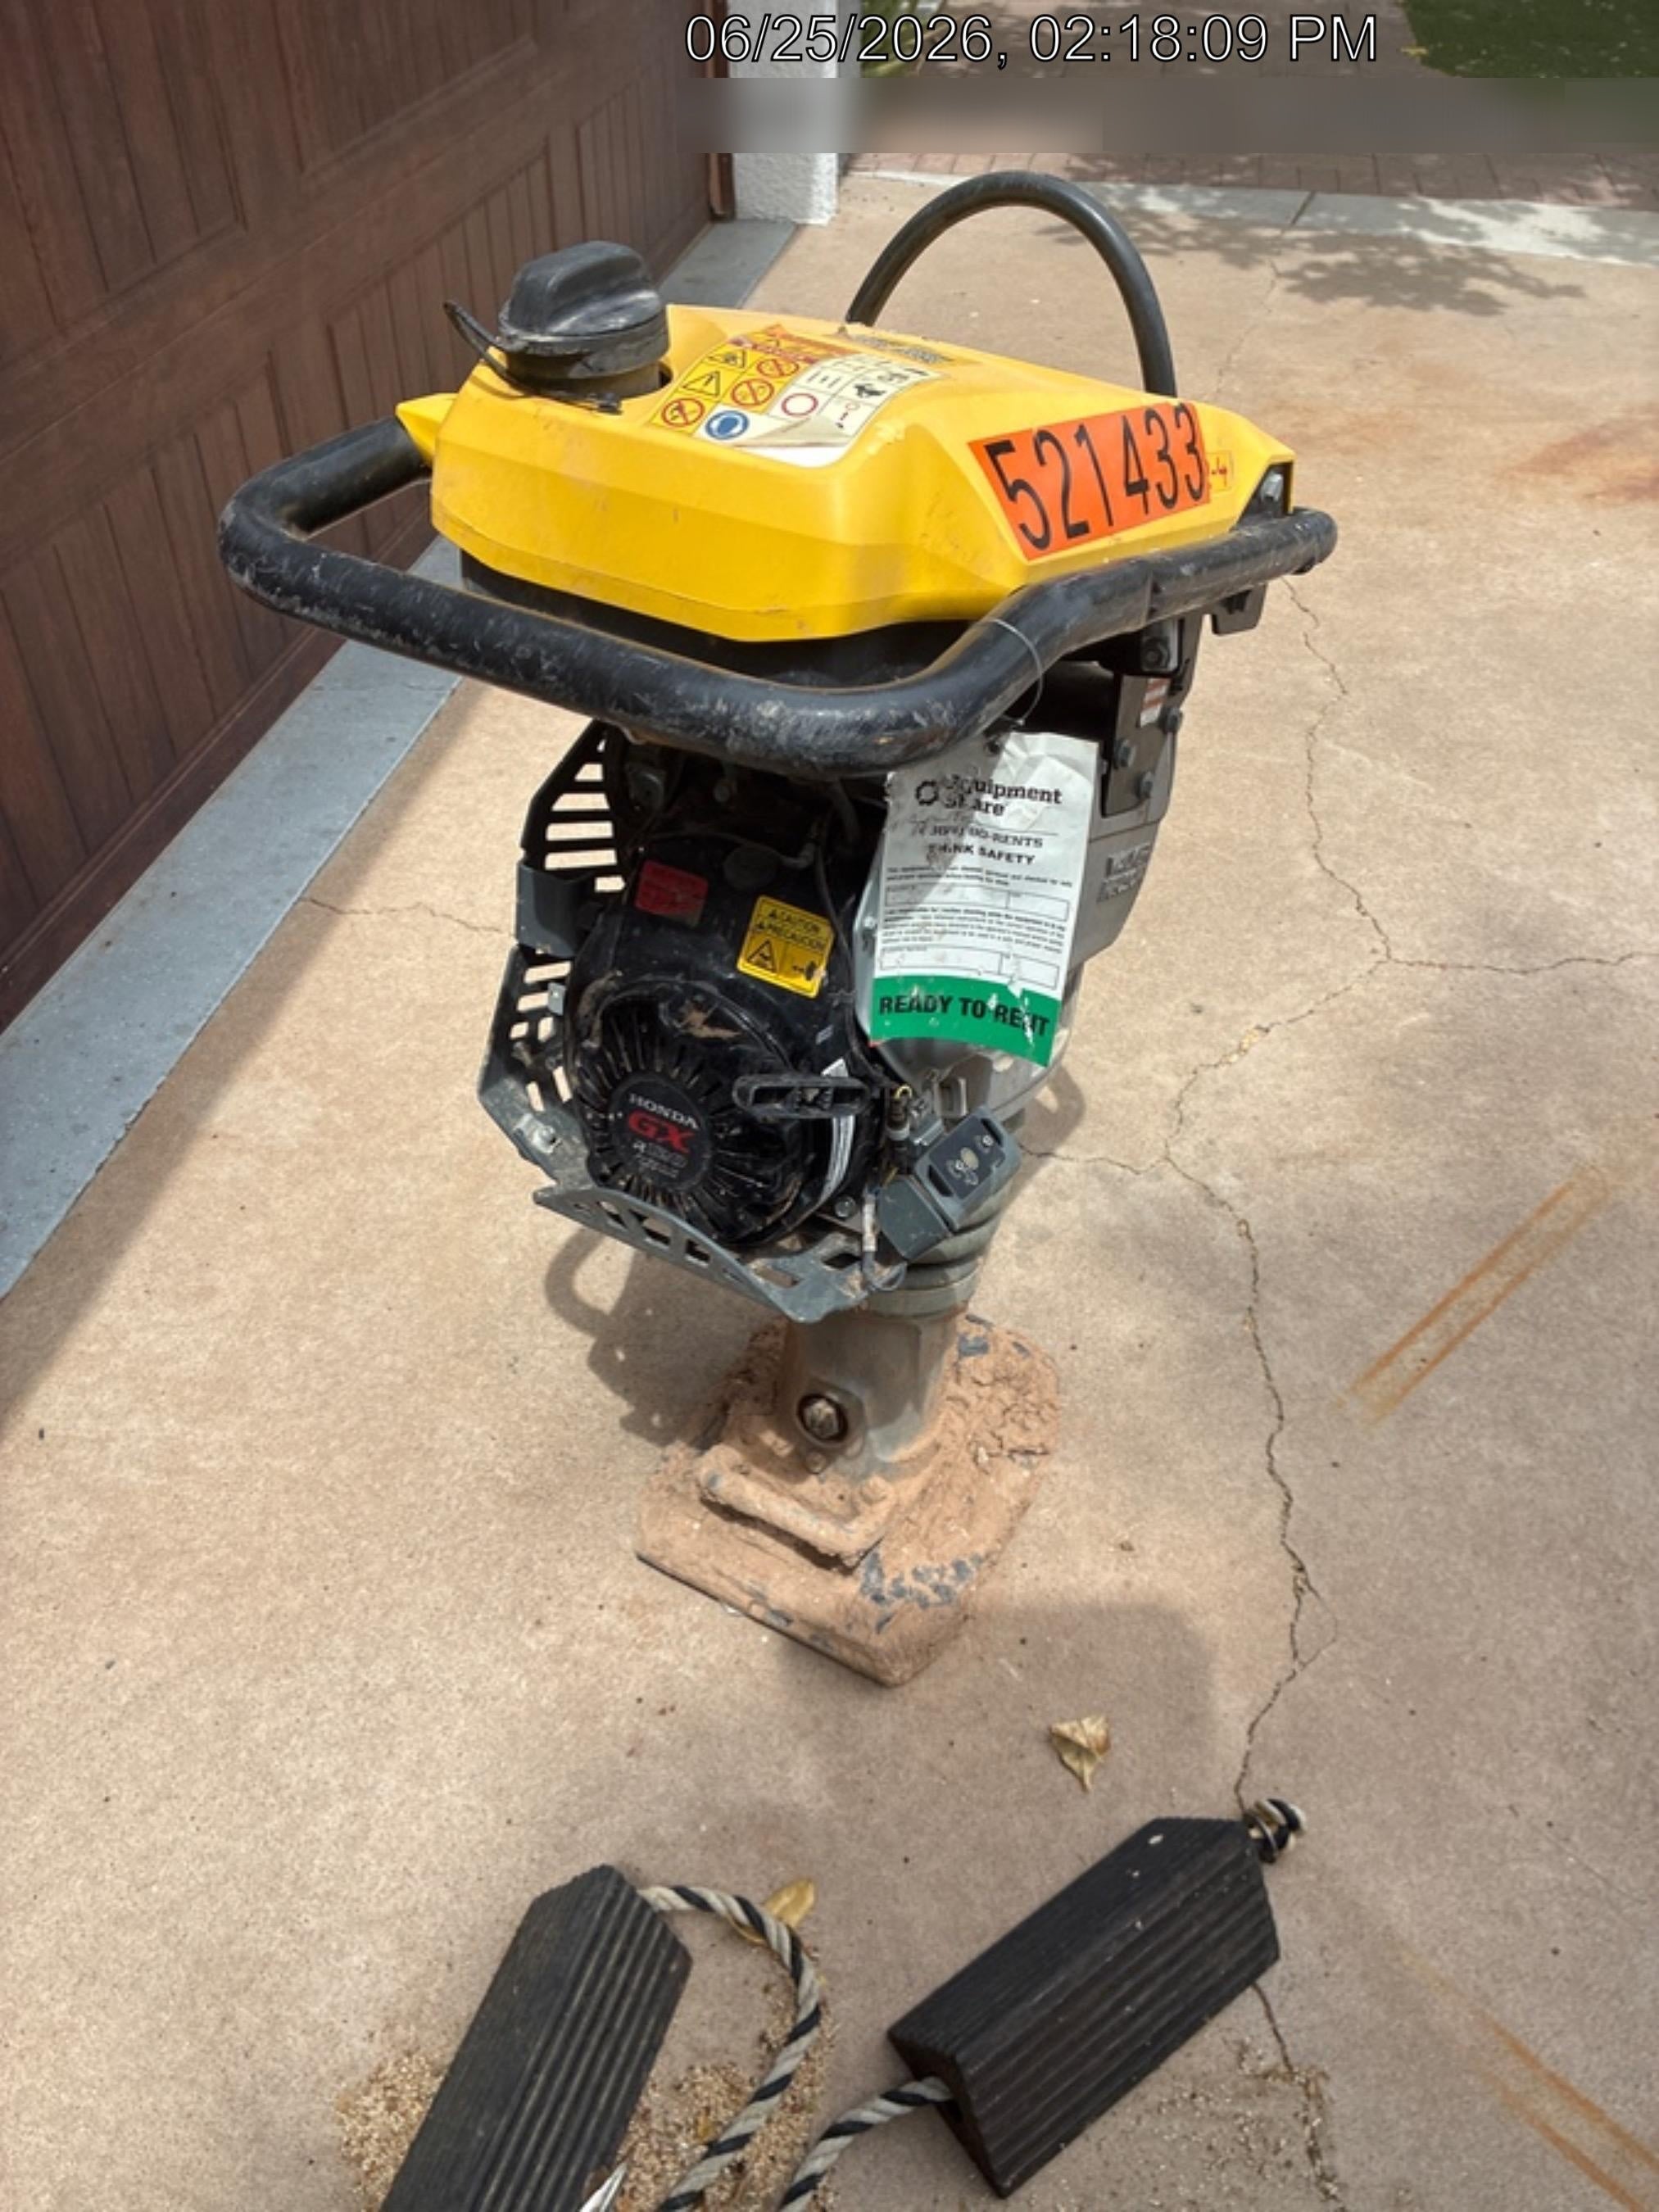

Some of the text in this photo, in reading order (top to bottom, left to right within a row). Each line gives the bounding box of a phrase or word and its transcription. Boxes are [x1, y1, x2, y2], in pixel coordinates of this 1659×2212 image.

[985, 402, 1205, 550] 521433
[978, 845, 1036, 865] SAFETY
[880, 994, 1049, 1036] READY TO RENT
[628, 1108, 696, 1154] GX
[629, 1093, 700, 1130] HONDA
